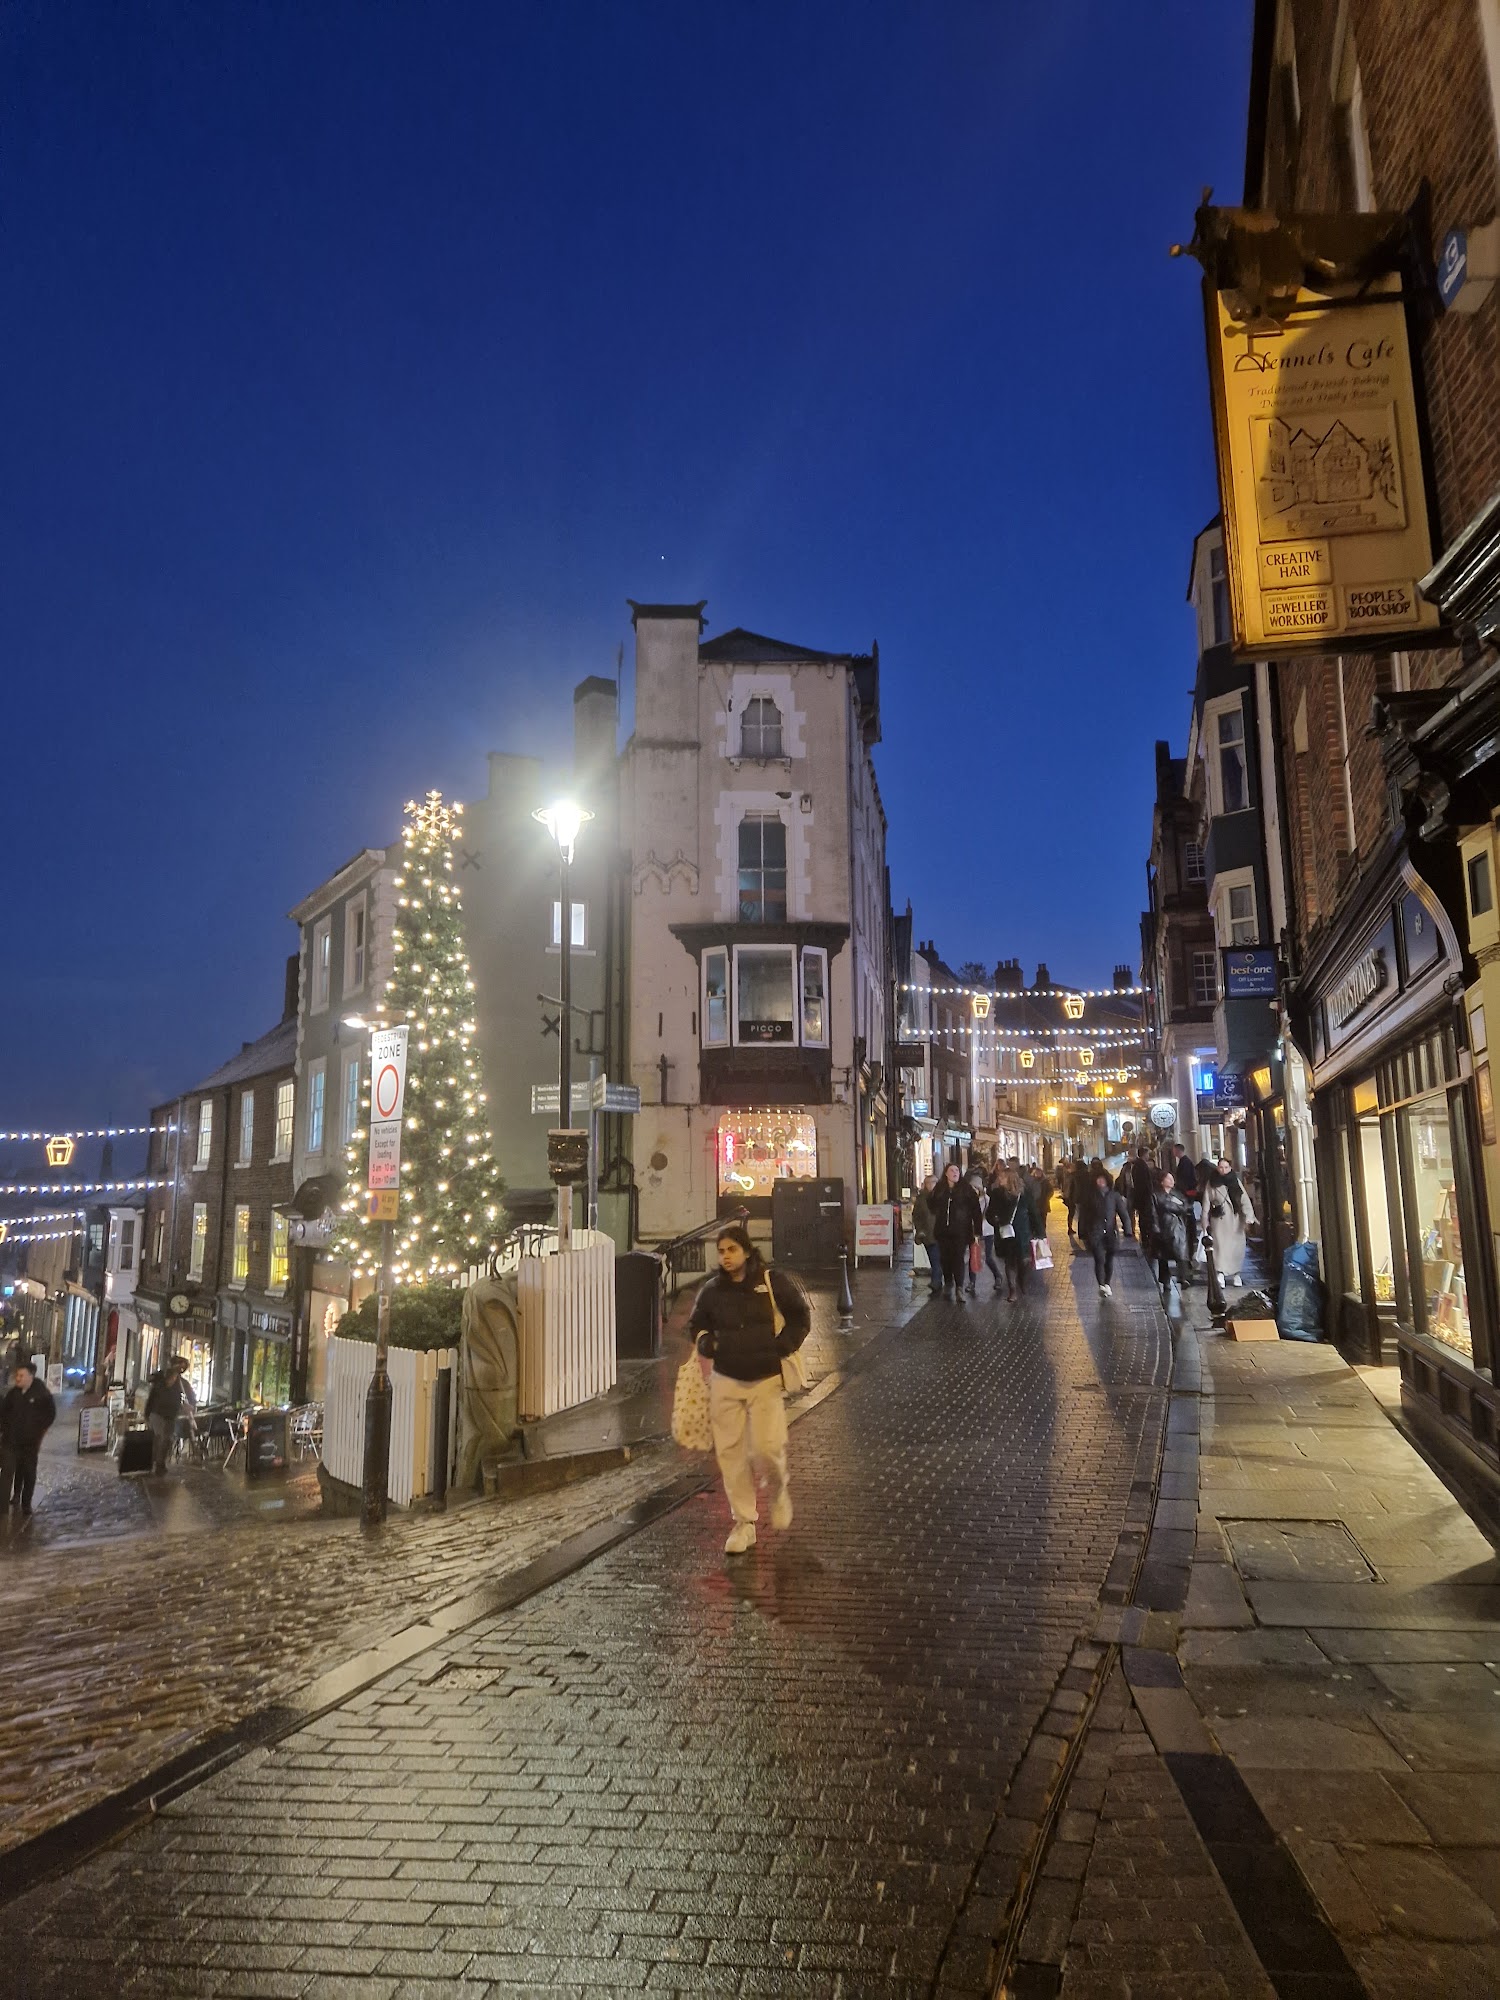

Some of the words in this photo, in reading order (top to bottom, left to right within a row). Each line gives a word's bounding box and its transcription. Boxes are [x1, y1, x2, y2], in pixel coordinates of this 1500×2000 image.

[1266, 550, 1322, 567] CREATIVE
[1280, 565, 1311, 578] HAIR
[1351, 589, 1405, 604] PEOPLE'S
[1269, 600, 1327, 615] JEWELLERY
[1350, 602, 1411, 618] BOOKSHOP
[1269, 612, 1329, 627] WORKSHOP
[1230, 966, 1272, 975] best-one
[750, 1025, 782, 1033] PICCO
[374, 1031, 407, 1044] PEDESTRIAN
[378, 1044, 401, 1059] ZONE
[374, 1127, 380, 1135] No
[381, 1125, 398, 1134] vehicles
[374, 1139, 388, 1149] Except
[377, 1151, 392, 1160] loading
